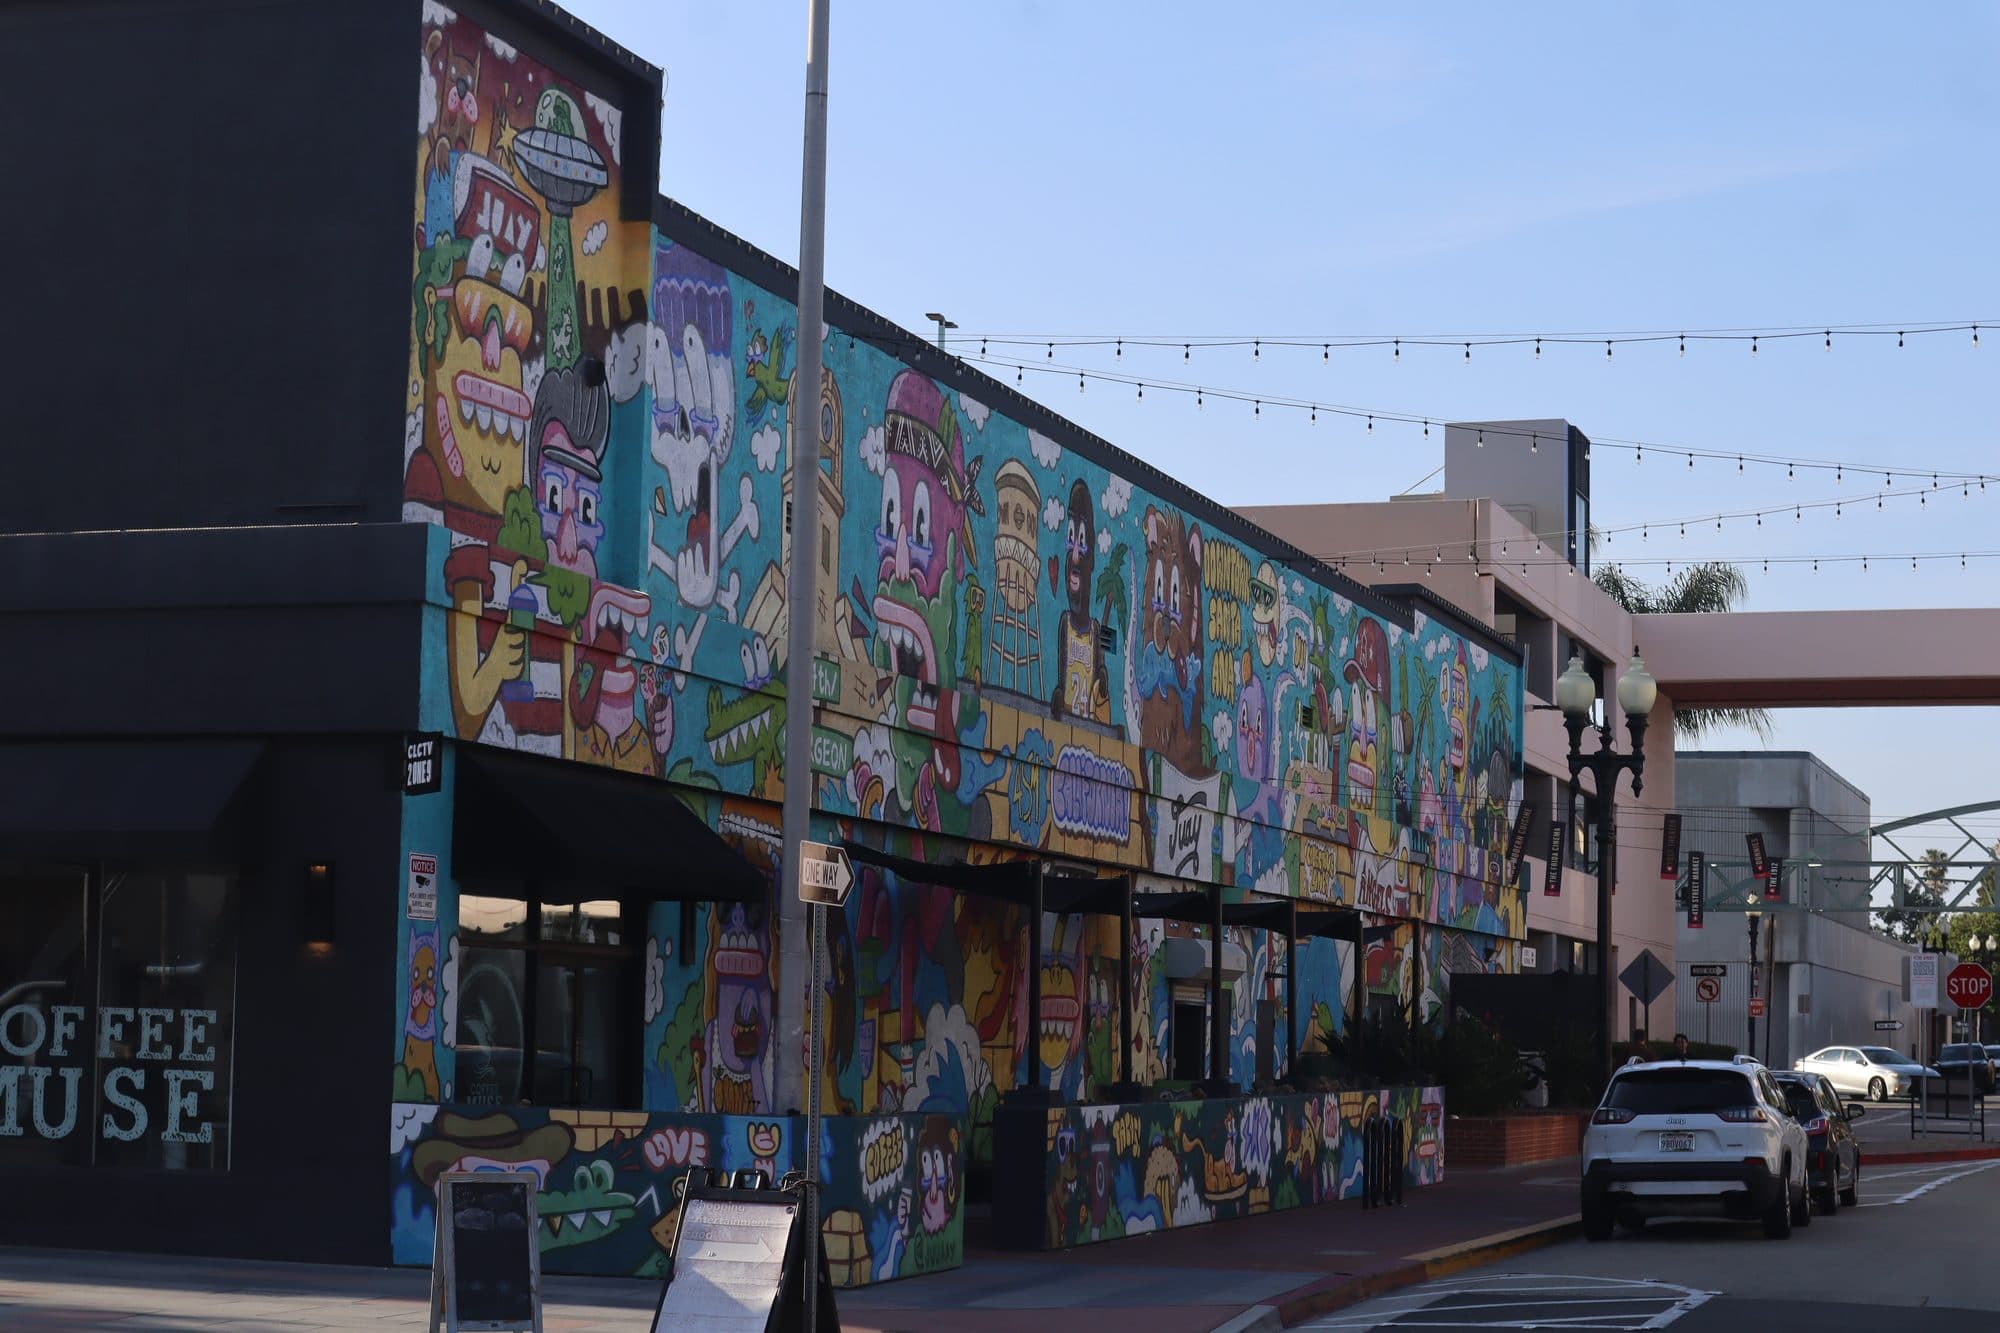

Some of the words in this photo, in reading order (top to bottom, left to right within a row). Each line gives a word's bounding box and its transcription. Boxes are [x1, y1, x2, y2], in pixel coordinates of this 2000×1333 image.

[1208, 596, 1242, 649] SANTA
[1211, 649, 1235, 707] ANA
[1071, 671, 1089, 718] 24
[1551, 827, 1561, 851] CINEMA
[412, 860, 435, 873] NOTICE
[804, 861, 820, 884] ONE
[822, 863, 839, 886] WAY
[1549, 871, 1558, 883] THE
[1691, 856, 1700, 880] MARKET
[1691, 881, 1700, 903] STREET
[1949, 977, 1989, 995] STOP
[865, 1123, 904, 1185] COFFEE
